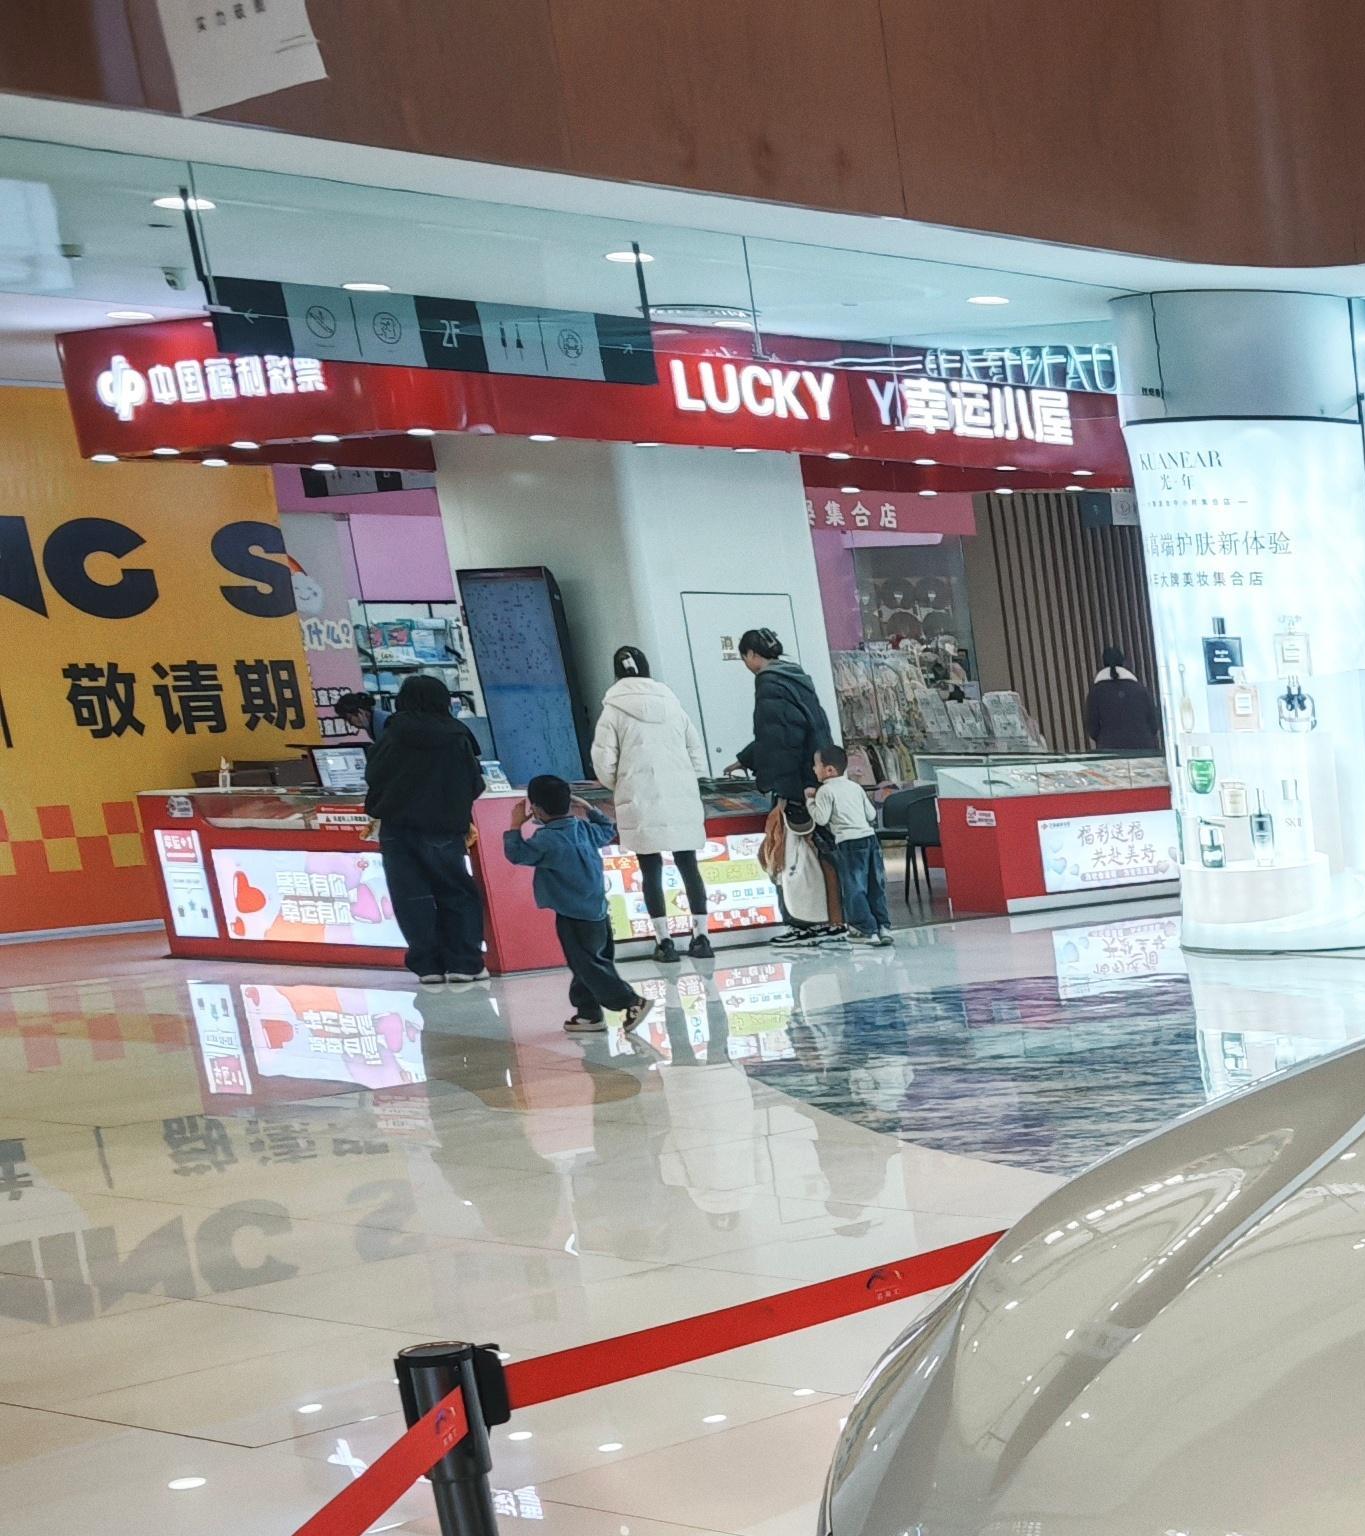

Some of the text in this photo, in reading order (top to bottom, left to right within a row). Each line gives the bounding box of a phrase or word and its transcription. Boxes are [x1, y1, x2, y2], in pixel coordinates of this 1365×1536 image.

[148, 355, 328, 405] 中国福利彩票
[669, 359, 835, 421] LUCKY
[900, 377, 1074, 446] 幸运小屋
[1139, 450, 1223, 471] KUANEAR
[62, 659, 305, 739] 敬请期
